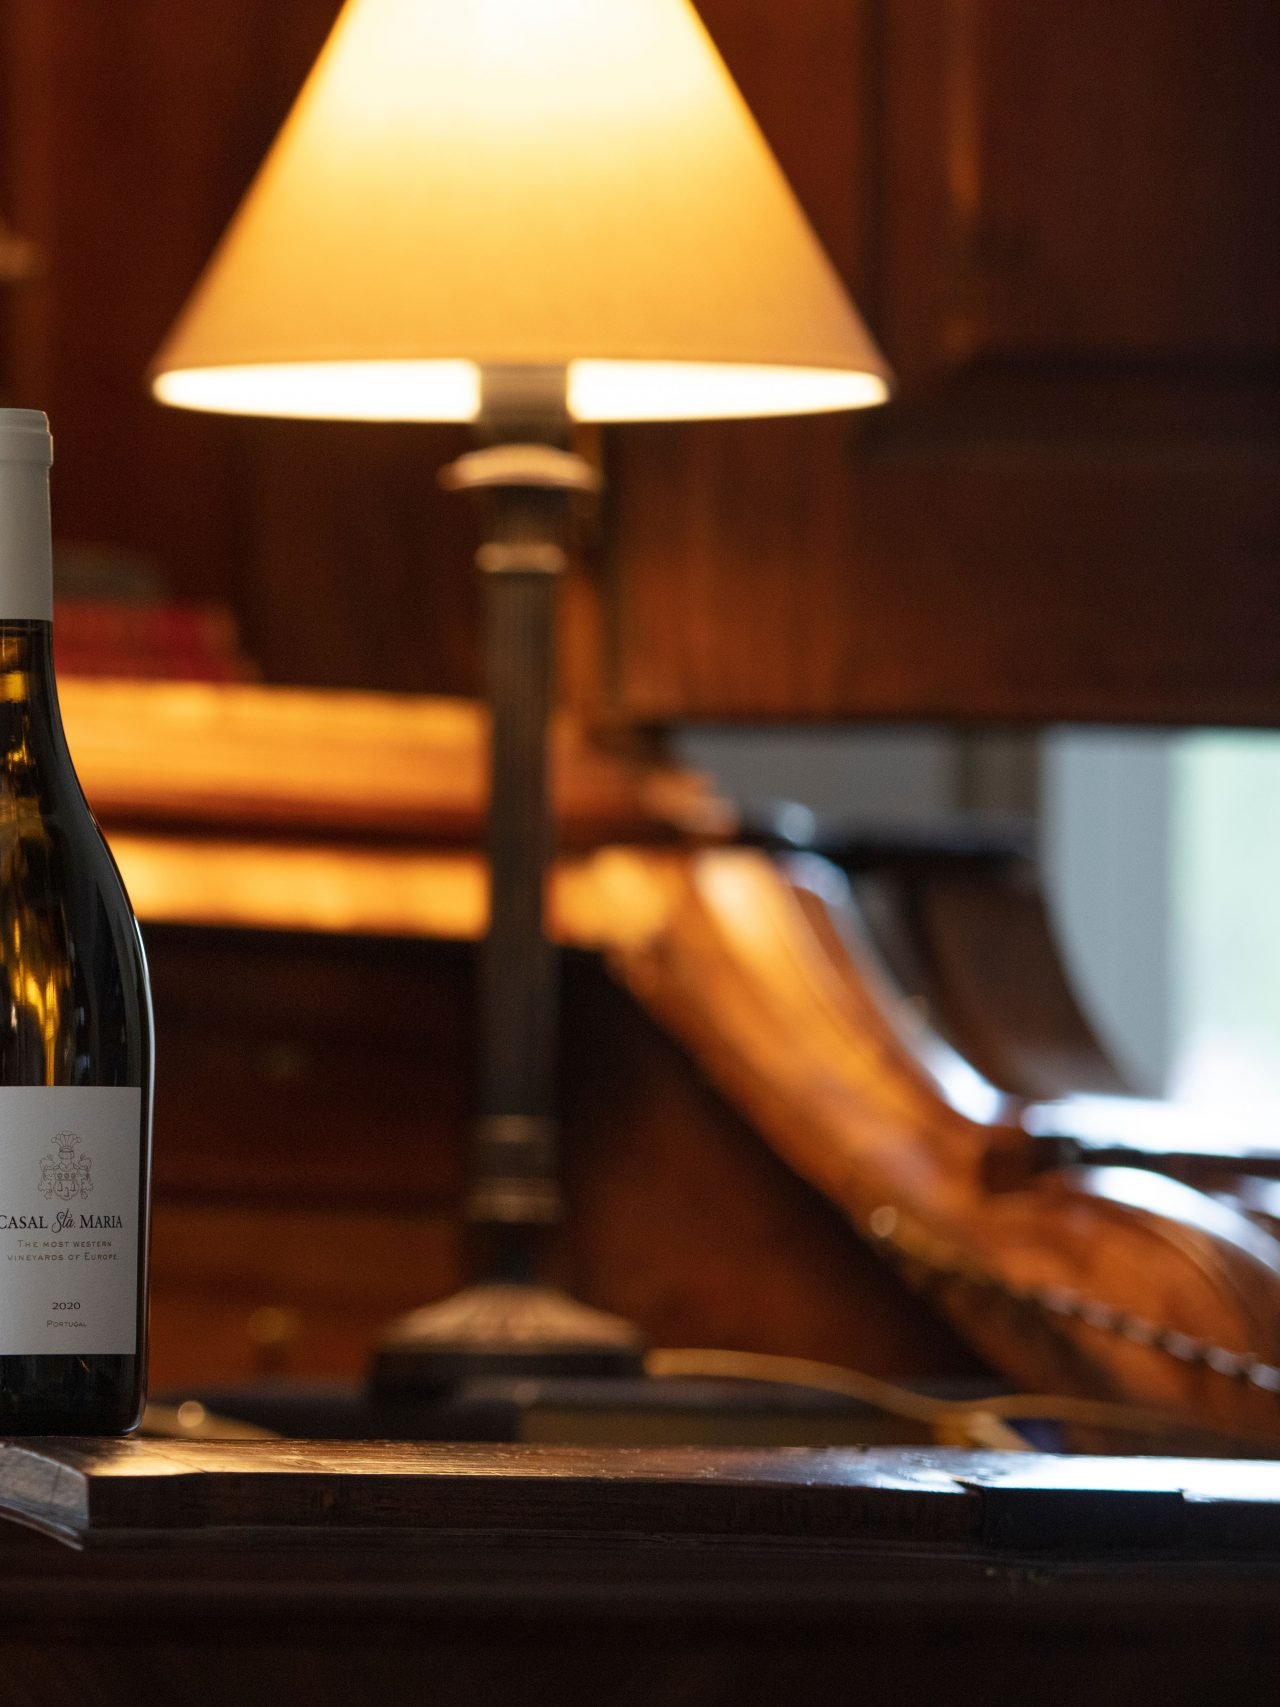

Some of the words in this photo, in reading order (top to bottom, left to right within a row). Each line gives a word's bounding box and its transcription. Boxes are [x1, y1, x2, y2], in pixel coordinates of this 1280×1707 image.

[80, 1214, 123, 1229] MARIA
[17, 1239, 38, 1248] THE
[84, 1252, 118, 1260] EUROPE
[51, 1301, 81, 1311] 2020
[46, 1320, 87, 1328] PORTUGAL
